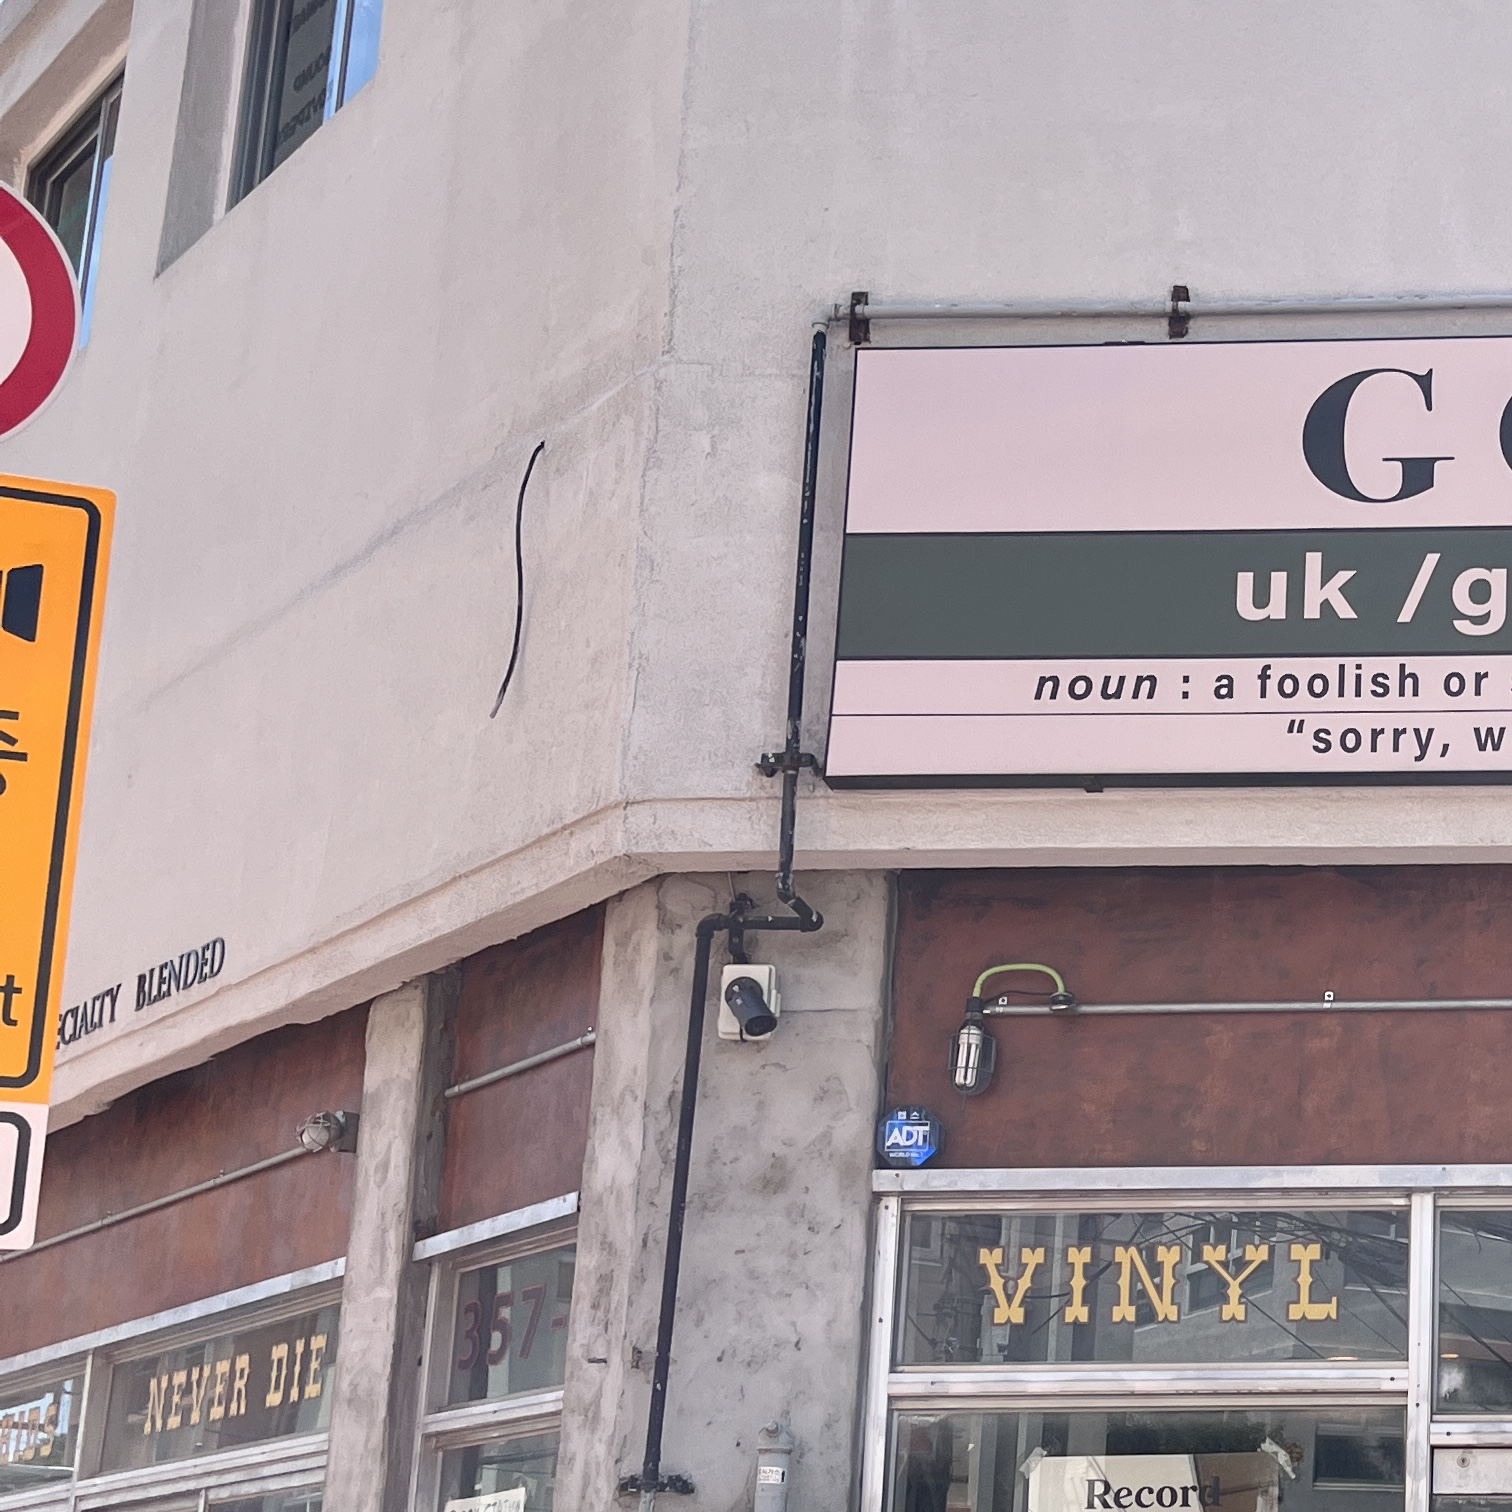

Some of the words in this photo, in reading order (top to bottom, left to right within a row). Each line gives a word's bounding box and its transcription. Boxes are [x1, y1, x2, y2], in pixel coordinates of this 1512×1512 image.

[1234, 552, 1358, 621] uk
[1034, 673, 1159, 701] noun
[1213, 676, 1236, 700] a
[1258, 663, 1421, 700] foolish
[1442, 672, 1490, 698] or
[134, 937, 226, 1012] BLENDED
[886, 1126, 930, 1146] ADT
[979, 1243, 1339, 1326] VINYL
[144, 1353, 249, 1436] NEVER
[265, 1333, 328, 1409] DIE
[1085, 1476, 1222, 1511] Record
